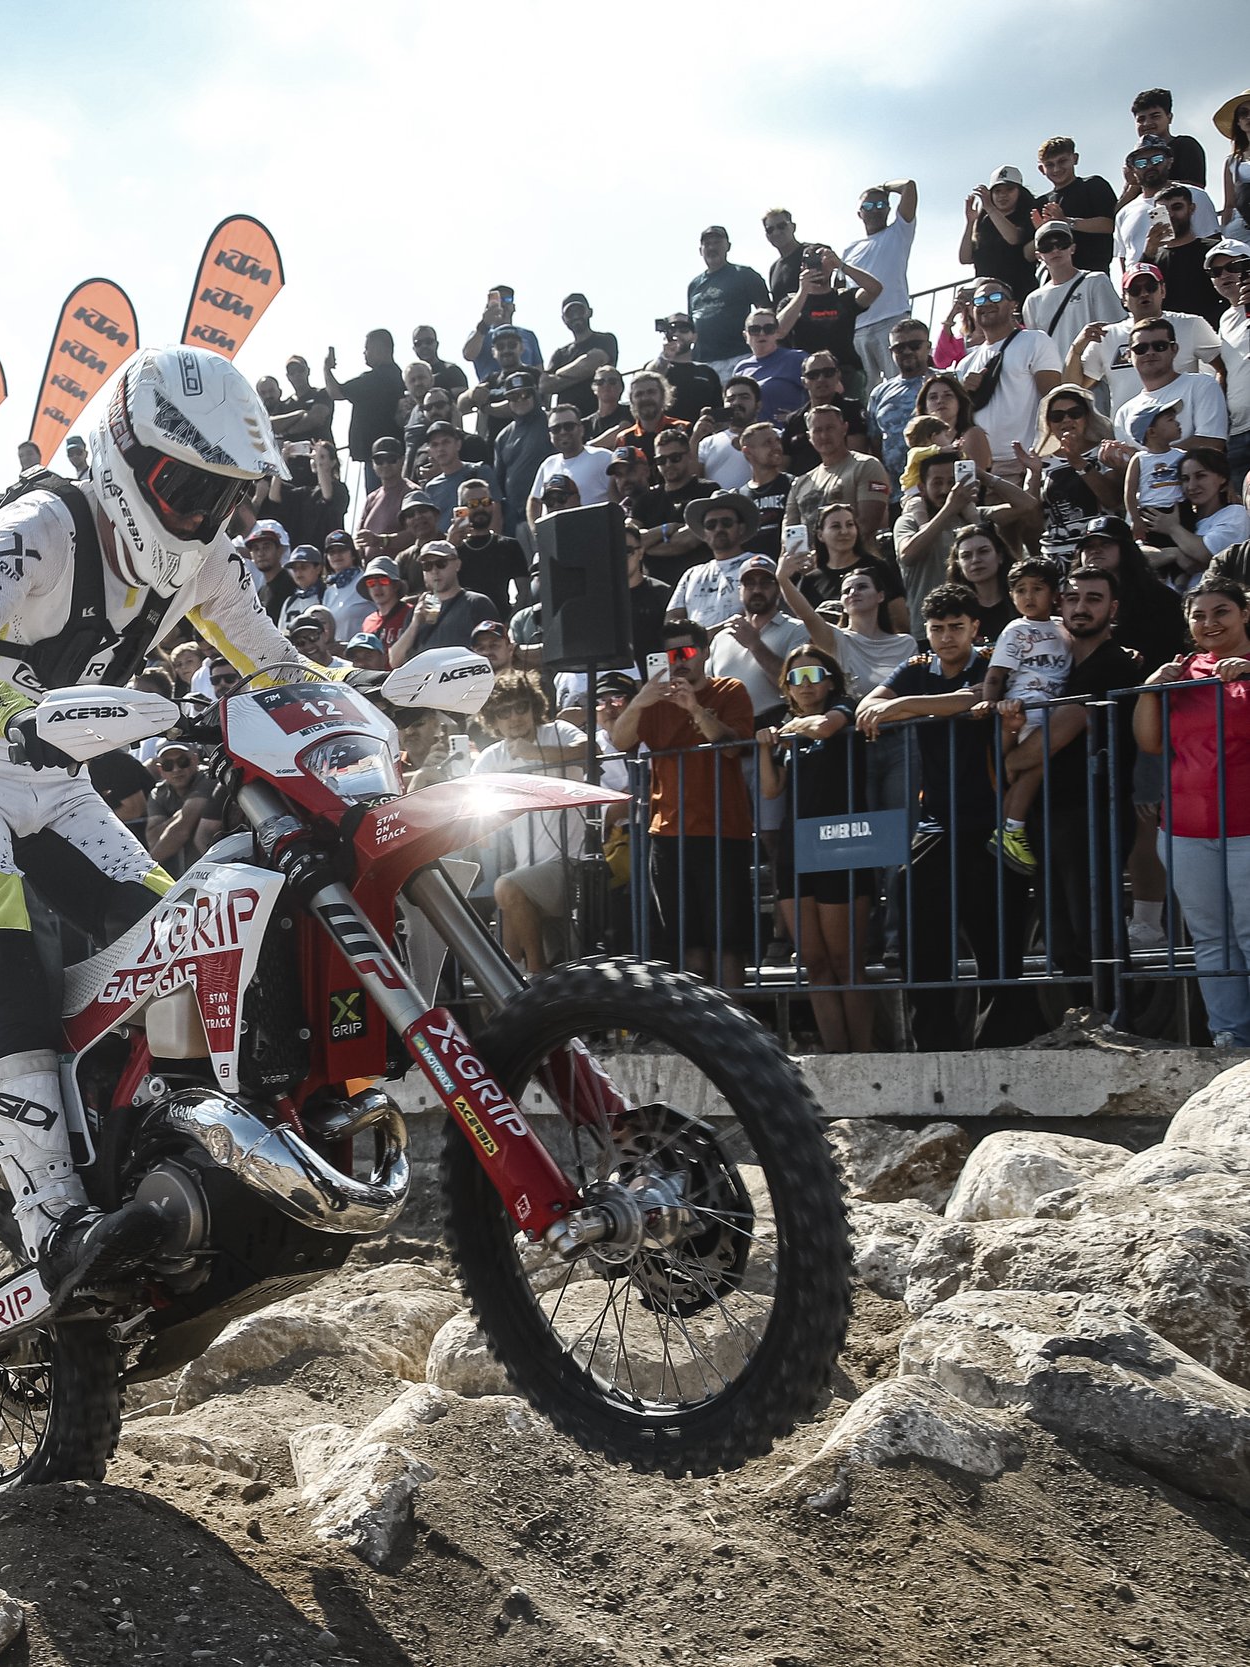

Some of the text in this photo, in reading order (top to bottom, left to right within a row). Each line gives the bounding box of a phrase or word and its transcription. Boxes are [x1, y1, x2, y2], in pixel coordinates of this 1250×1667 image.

[214, 249, 272, 286] KTM
[199, 287, 254, 320] KTM
[73, 306, 129, 347] KTM
[190, 324, 236, 352] KTM
[59, 339, 108, 375] KTM
[50, 374, 88, 401] KTM
[43, 406, 71, 427] KTM
[302, 700, 343, 717] 12
[376, 810, 400, 827] STAY
[376, 824, 389, 836] ON
[375, 825, 407, 845] TRACK
[819, 822, 872, 840] KEMER BLD.
[98, 963, 198, 1003] GASGAS
[209, 992, 228, 1004] STAY
[218, 1004, 230, 1015] ON
[331, 992, 362, 1025] X
[206, 1017, 232, 1029] TRACK
[332, 1022, 362, 1038] GRIP
[262, 1074, 290, 1085] X-GRIP
[420, 1046, 454, 1092] MOTOREX
[426, 1019, 528, 1137] X-GRIP
[454, 1101, 496, 1154] ACERBIS
